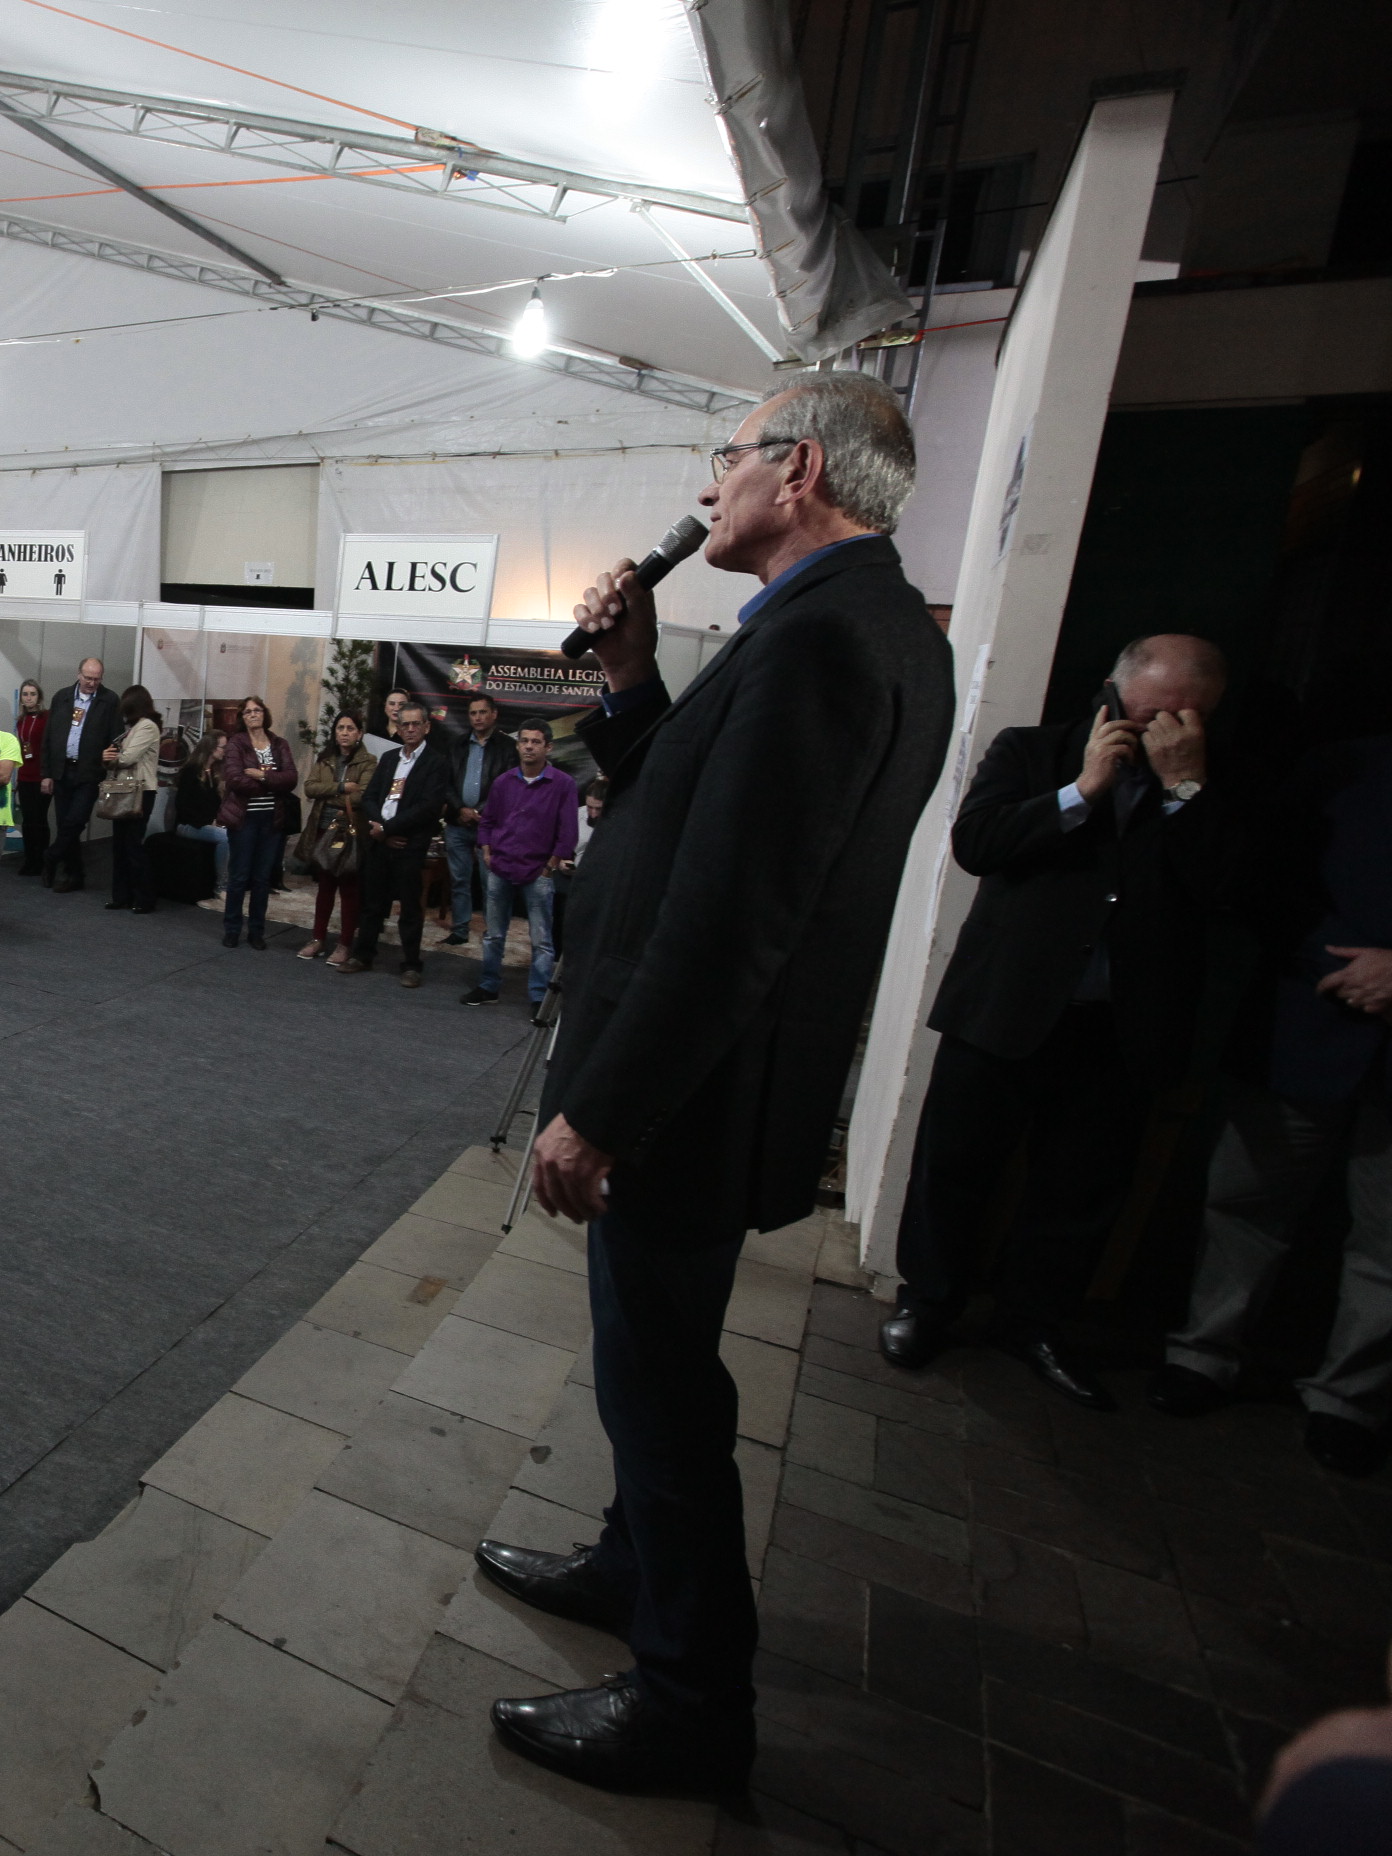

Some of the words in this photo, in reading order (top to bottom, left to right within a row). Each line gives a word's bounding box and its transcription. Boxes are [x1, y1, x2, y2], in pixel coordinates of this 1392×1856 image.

[352, 560, 478, 593] ALESC
[488, 664, 564, 680] ASSEMBLEIA
[568, 669, 608, 682] LEGIS
[486, 680, 502, 690] DO
[504, 681, 544, 693] ESTADO
[545, 685, 560, 695] DE
[561, 686, 595, 697] SANTA
